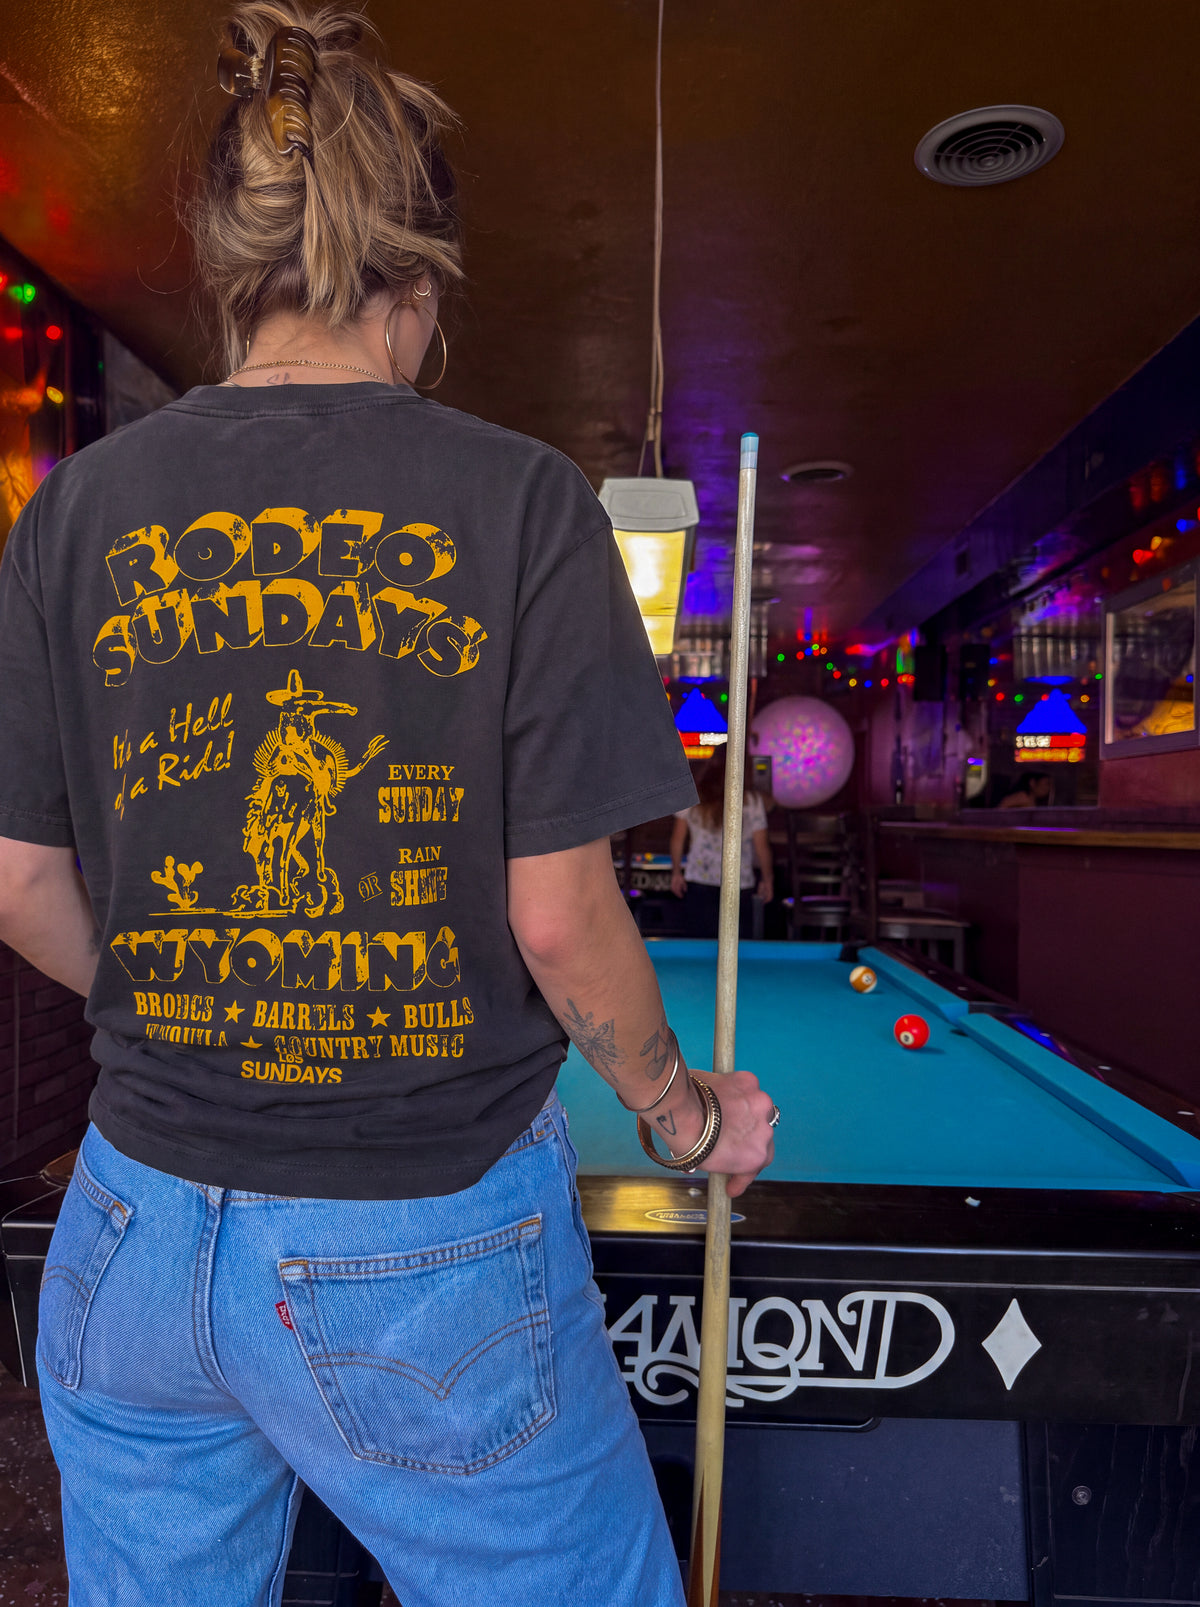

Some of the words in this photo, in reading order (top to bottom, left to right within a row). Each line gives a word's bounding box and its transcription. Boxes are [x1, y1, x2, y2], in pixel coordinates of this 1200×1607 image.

[105, 507, 457, 607] RODEO
[92, 577, 489, 687] SUNDAYS
[140, 731, 158, 754] a
[169, 692, 234, 743] Hell
[130, 777, 148, 799] a
[157, 730, 235, 790] Ride!
[387, 764, 455, 781] EVERY
[377, 786, 465, 824] SUNDAY
[398, 846, 442, 865] RAIN
[358, 873, 383, 901] OR
[110, 926, 461, 992] WYOMING
[133, 991, 215, 1022] BRONCS
[252, 1000, 355, 1031] BARRELS
[403, 997, 475, 1029] BULLS
[273, 1034, 384, 1060] COUNTRY
[389, 1034, 464, 1058] MUSIC
[240, 1060, 343, 1085] SUNDAYS
[598, 1290, 955, 1408] AMOND
